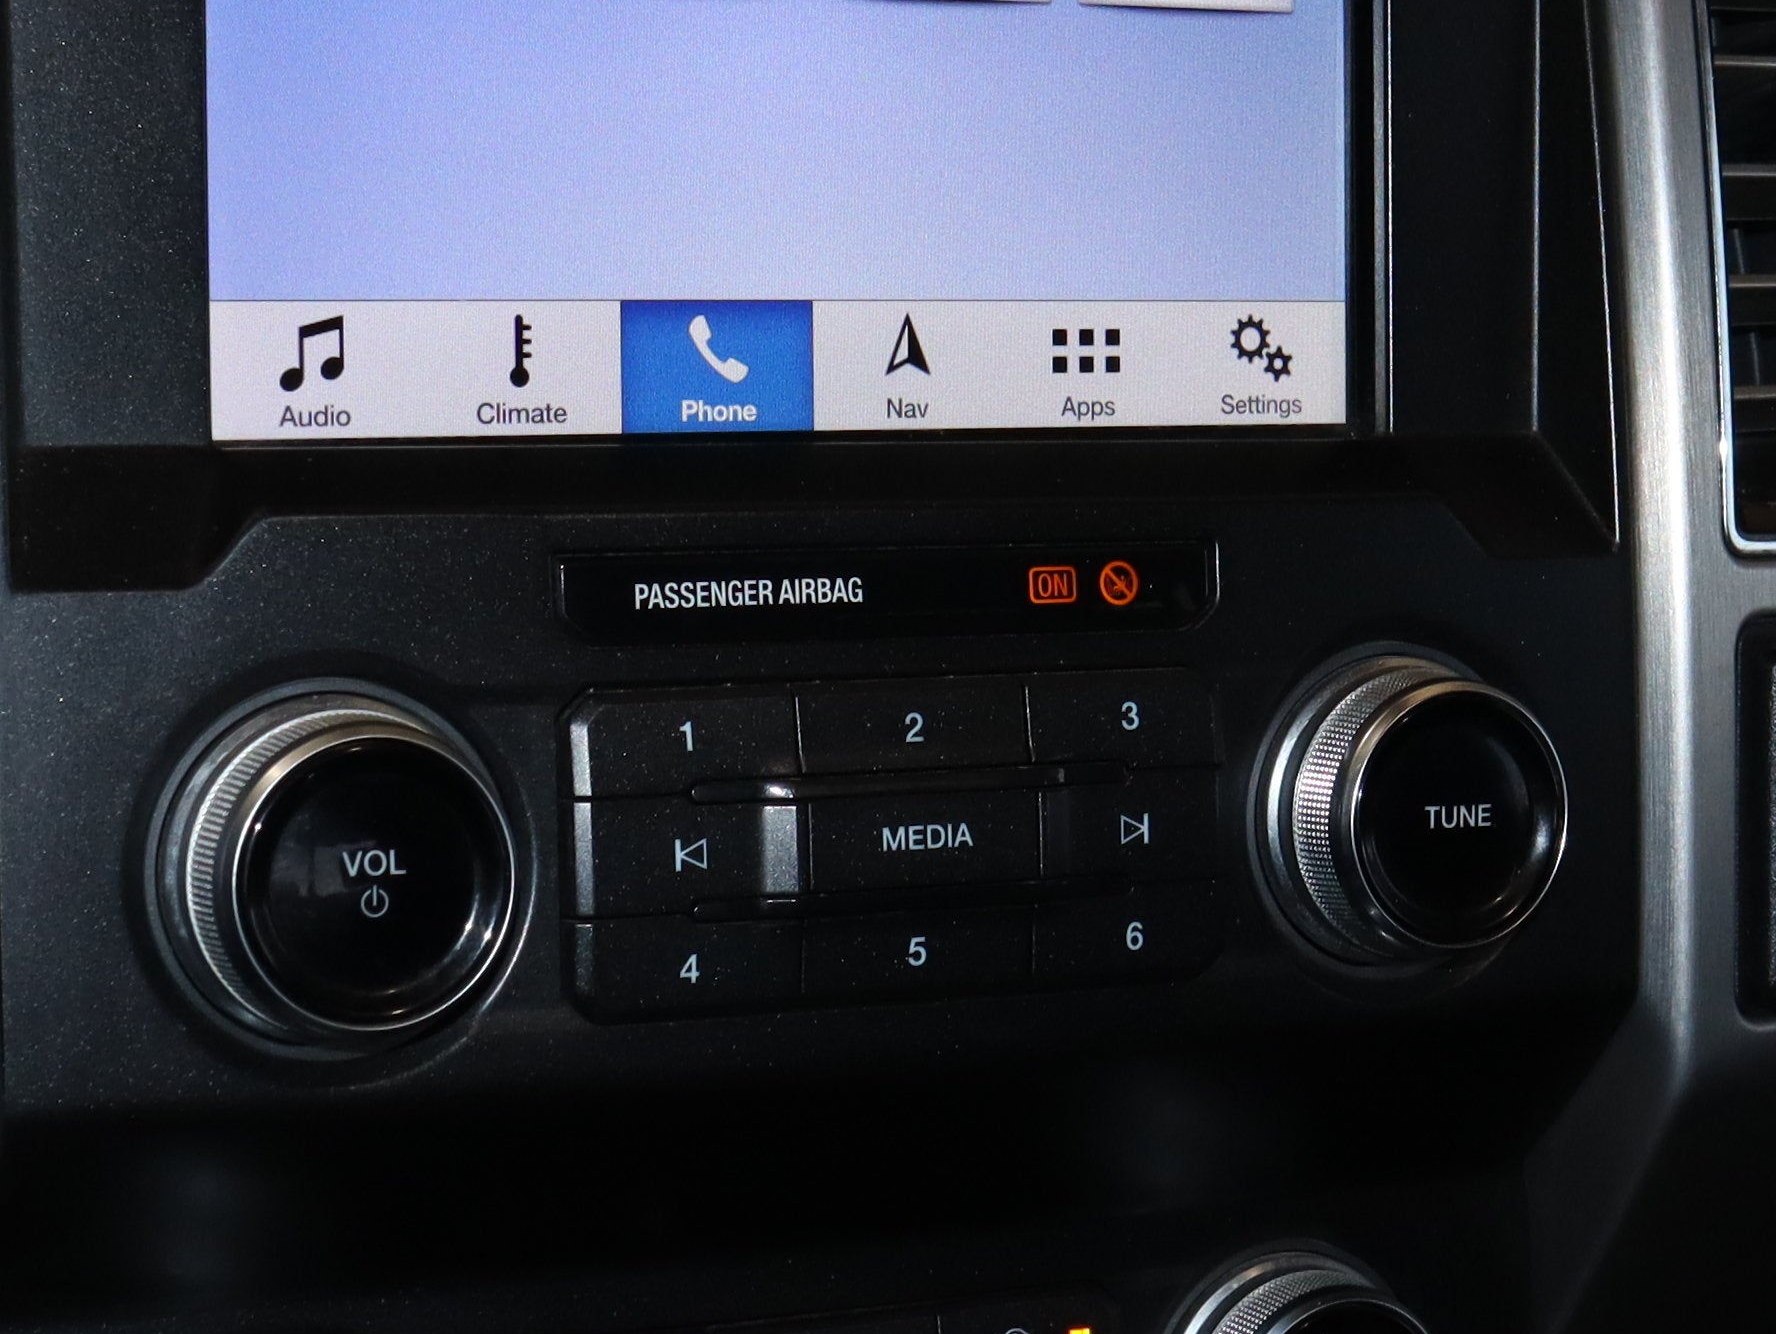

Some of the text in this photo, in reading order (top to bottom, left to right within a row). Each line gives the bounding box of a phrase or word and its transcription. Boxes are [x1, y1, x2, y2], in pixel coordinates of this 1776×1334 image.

[279, 404, 352, 428] Audio
[476, 402, 568, 425] Climate
[681, 399, 757, 422] Phone
[886, 397, 929, 419] Nav
[1061, 396, 1116, 422] Apps
[1220, 393, 1303, 419] Settings
[634, 576, 863, 610] PASSENGER AIRBAG
[1037, 573, 1068, 598] ON
[905, 712, 924, 743] 2
[1121, 701, 1140, 731] 3
[679, 721, 693, 752] 1
[1424, 803, 1492, 829] TUNE
[882, 822, 974, 852] MEDIA
[342, 849, 406, 877] VOL
[1126, 921, 1144, 951] 6
[908, 936, 927, 967] 5
[679, 953, 700, 984] 4
